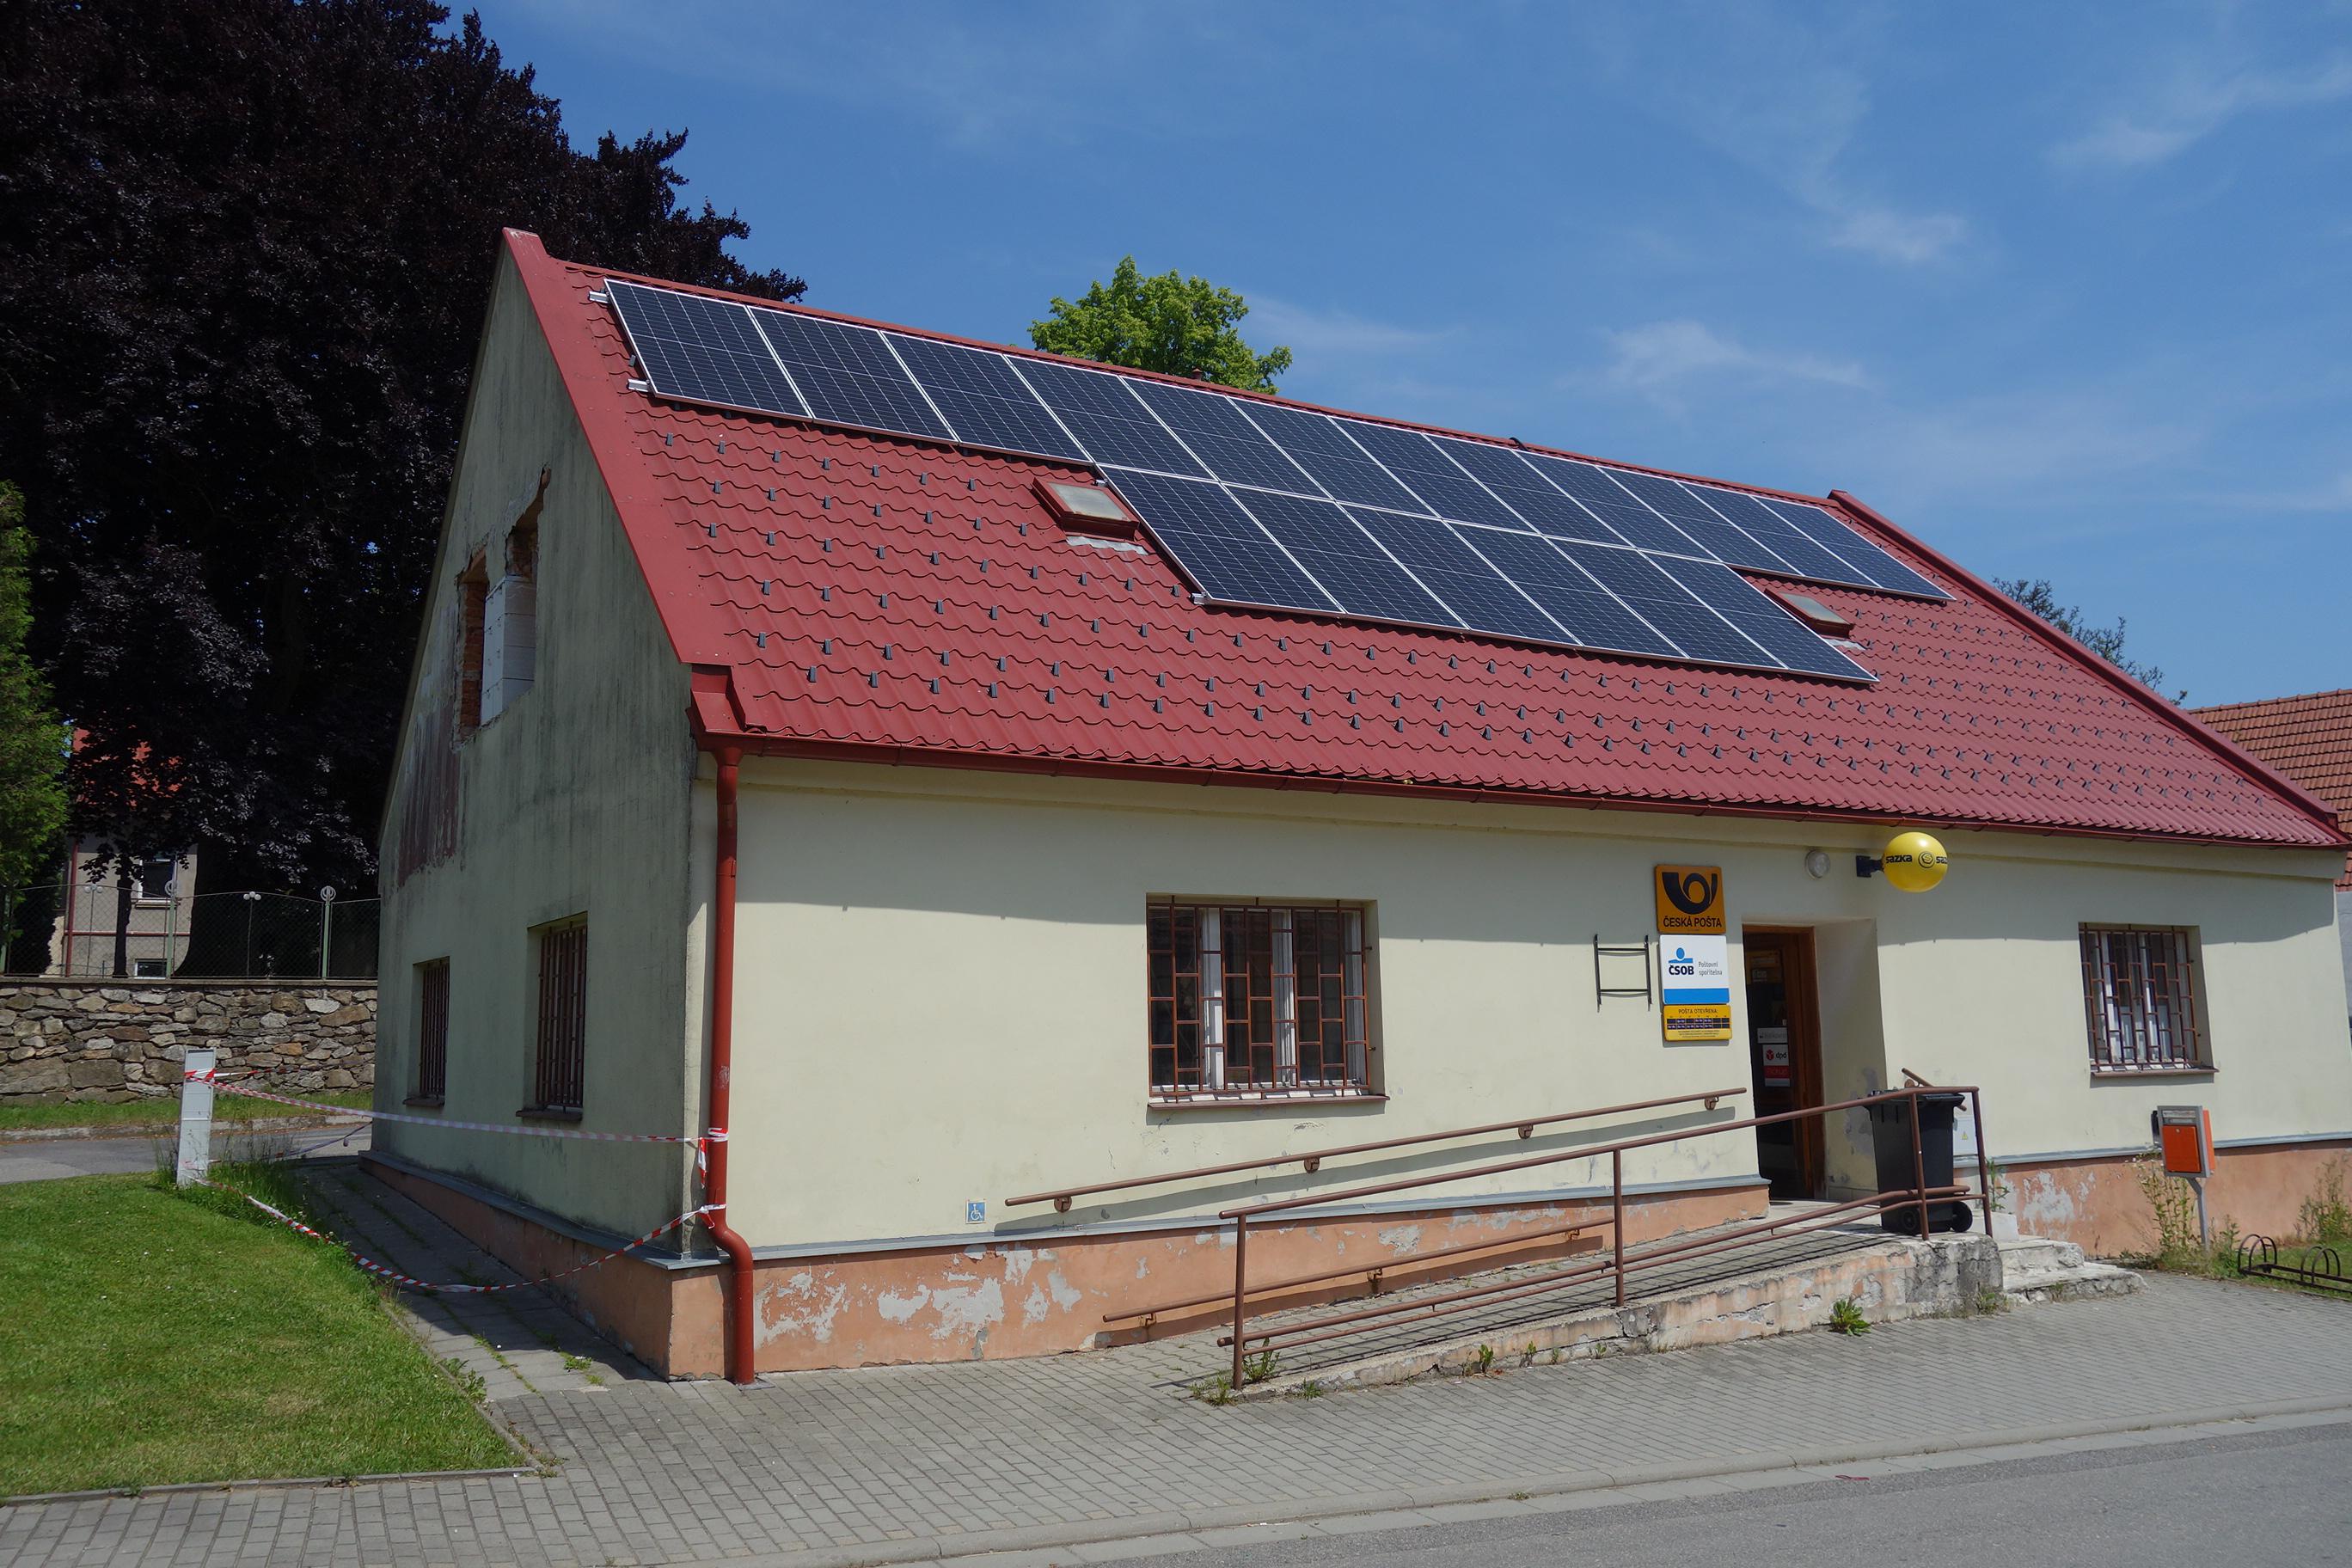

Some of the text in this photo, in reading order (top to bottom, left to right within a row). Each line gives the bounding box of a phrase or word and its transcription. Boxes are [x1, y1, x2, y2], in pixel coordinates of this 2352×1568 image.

[1663, 916, 1722, 927] ČESKÁ POŠTA
[1669, 965, 1694, 975] ČSOB
